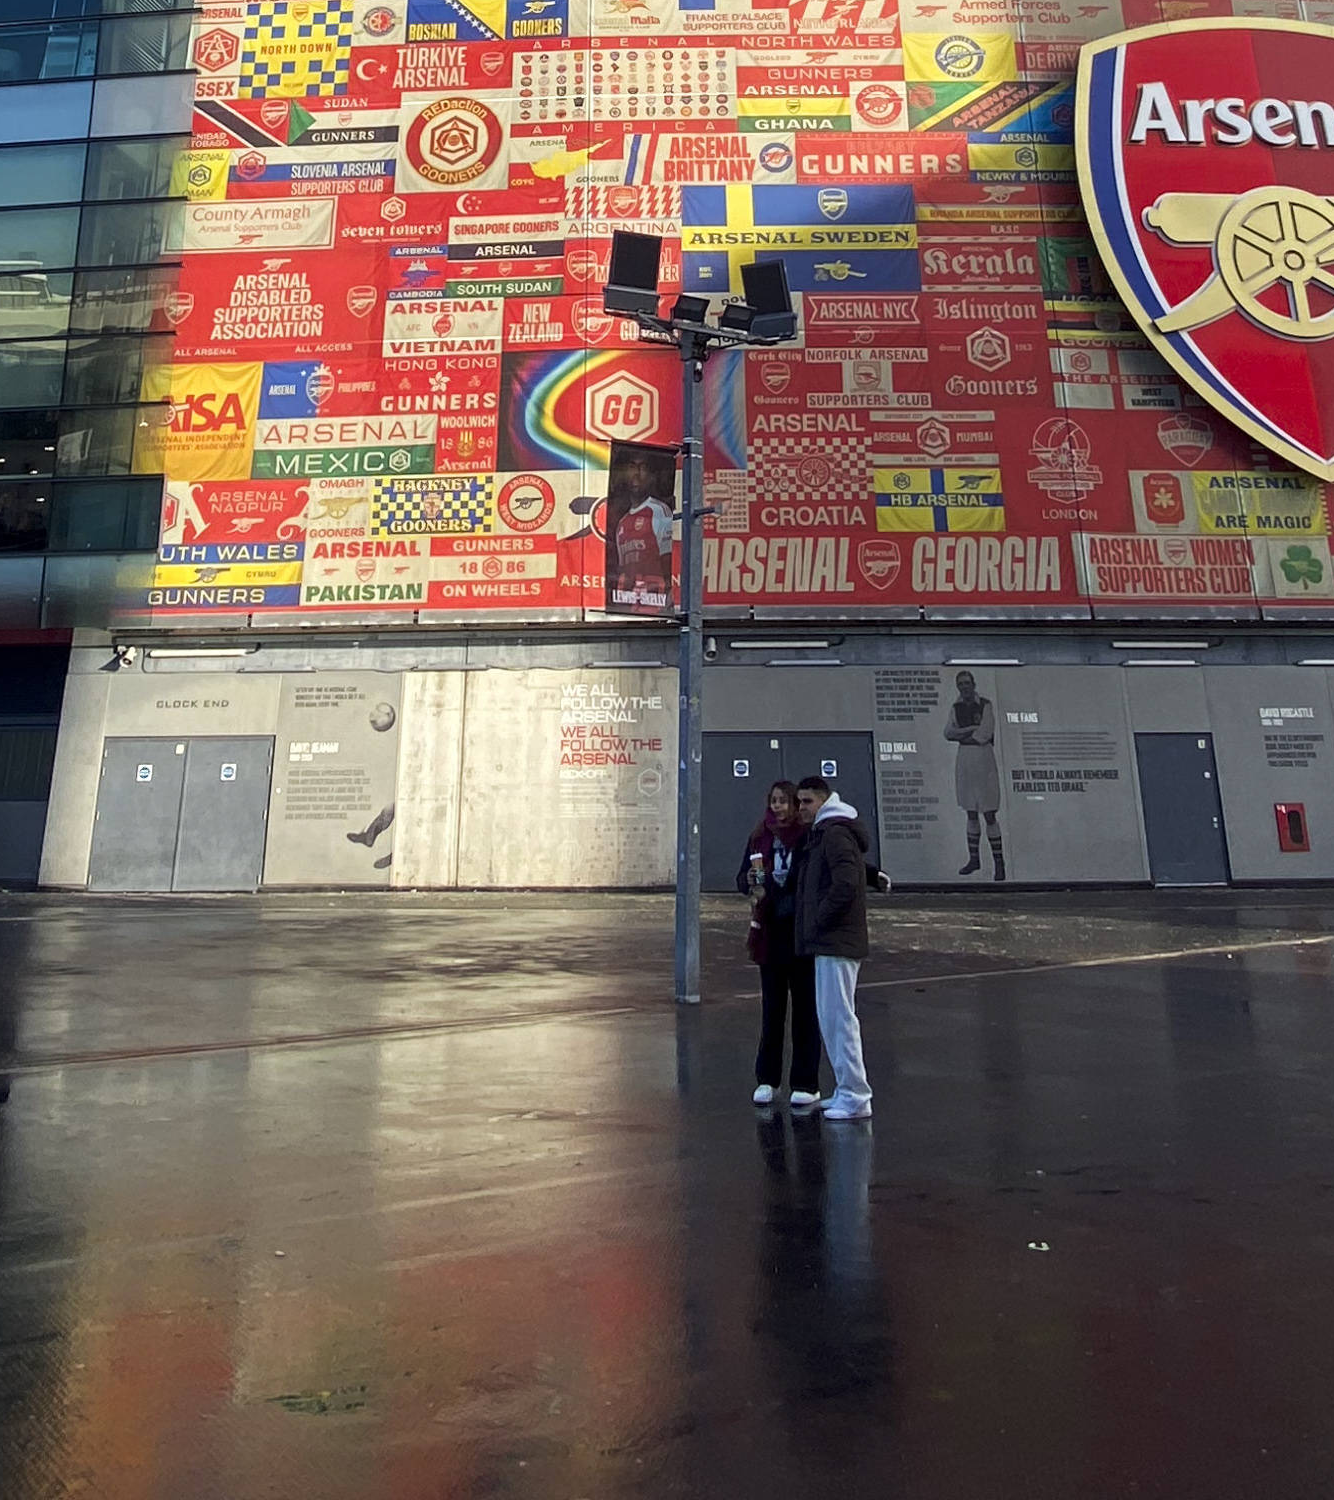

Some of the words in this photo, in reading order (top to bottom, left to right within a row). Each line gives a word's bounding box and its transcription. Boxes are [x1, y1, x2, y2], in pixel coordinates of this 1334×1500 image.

[959, 0, 1008, 10] Armed
[1011, 0, 1061, 11] Forces
[685, 13, 729, 22] FRANCE
[731, 12, 782, 21] D'ALSACE
[952, 12, 1033, 26] Supporters
[1037, 11, 1071, 24] Club
[683, 21, 749, 32] SUPPORTERS
[751, 20, 786, 31] CLUB
[261, 44, 296, 56] NORTH
[299, 42, 333, 54] DOWN
[740, 36, 813, 49] NORTH
[823, 35, 896, 48] WALES
[396, 44, 468, 68] TÜRKİYE
[392, 65, 469, 89] ARSENAL
[767, 66, 874, 80] GUNNERS
[744, 83, 843, 96] ARSENAL
[324, 97, 369, 109] SUDAN
[421, 99, 488, 121] REDaction
[754, 118, 834, 131] GHANA
[311, 130, 375, 142] GUNNERS
[668, 136, 751, 159] ARSENAL
[290, 163, 338, 179] SLOVENIA
[341, 160, 387, 177] ARSENAL
[663, 158, 756, 182] BRITTANY
[802, 153, 963, 176] GUNNERS
[417, 163, 486, 185] GOONERS
[290, 181, 355, 196] SUPPORTERS
[358, 179, 384, 194] CLUB
[192, 207, 247, 225] County
[249, 204, 310, 224] Armagh
[453, 221, 511, 236] SINGAPORE
[513, 220, 560, 234] GOONERS
[567, 220, 678, 240] ARGENTINA
[689, 230, 804, 246] ARSENAL
[810, 229, 910, 245] SWEDEN
[395, 245, 444, 256] ARSENAL
[475, 242, 537, 257] ARSENAL
[923, 246, 1035, 277] Kerala
[233, 271, 310, 291] ARSENAL
[388, 289, 444, 300] CAMBODIA
[456, 283, 503, 297] SOUTH
[505, 282, 553, 295] SUDAN
[229, 289, 312, 308] DISABLED
[213, 304, 324, 324] SUPPORTERS
[389, 299, 499, 315] ARSENAL
[523, 303, 551, 321] NEW
[931, 297, 1037, 323] Islington
[210, 321, 324, 341] ASSOCIATION
[508, 321, 563, 343] ZEALAND
[389, 339, 497, 354] VIETNAM
[807, 349, 862, 362] NORFOLK
[869, 347, 927, 361] ARSENAL
[384, 357, 438, 371] HONG
[445, 356, 498, 370] KONG
[944, 374, 1038, 397] Gooners
[380, 391, 498, 412] GUNNERS
[808, 394, 889, 406] SUPPORTERS
[896, 394, 929, 406] CLUB
[600, 394, 643, 426] GG
[440, 414, 496, 430] WOOLWICH
[751, 413, 866, 433] ARSENAL
[262, 420, 429, 445] ARSENAL
[318, 479, 365, 490] OMAGH
[393, 477, 474, 493] HACKNEY
[1208, 476, 1306, 490] ARSENAL
[208, 490, 288, 503] ARSENAL
[890, 493, 913, 507] HB
[916, 493, 989, 507] ARSENAL
[210, 501, 285, 515] NAGPUR
[759, 505, 867, 526] CROATIA
[1042, 508, 1098, 521] LONDON
[390, 518, 473, 534] GOONERS
[1214, 515, 1249, 529] ARE
[1256, 515, 1312, 529] MAGIC
[308, 527, 365, 539] GOONERS
[224, 543, 299, 560] WALES
[312, 539, 422, 560] ARSENAL
[452, 538, 535, 554] GUNNERS
[1089, 538, 1164, 566] ARSENAL
[1189, 538, 1256, 566] WOMEN
[911, 536, 1062, 593] GEORGIA
[1096, 566, 1207, 594] SUPPORTERS
[1209, 567, 1253, 594] CLUB
[147, 587, 266, 606] GUNNERS
[305, 581, 423, 604] PAKISTAN
[442, 584, 467, 598] ON
[470, 582, 542, 598] WHEELS
[612, 589, 667, 608] LEWIS-SKELLY
[560, 684, 588, 698] WE
[591, 684, 620, 697] ALL
[156, 700, 198, 710] CLOCK
[202, 699, 229, 708] END
[560, 696, 630, 710] FOLLOW
[630, 696, 662, 710] THE
[560, 710, 638, 723] ARSENAL
[560, 726, 586, 739] WE
[589, 726, 619, 738] ALL
[560, 739, 630, 752] FOLLOW
[630, 738, 662, 752] THE
[560, 752, 638, 766] ARSENAL
